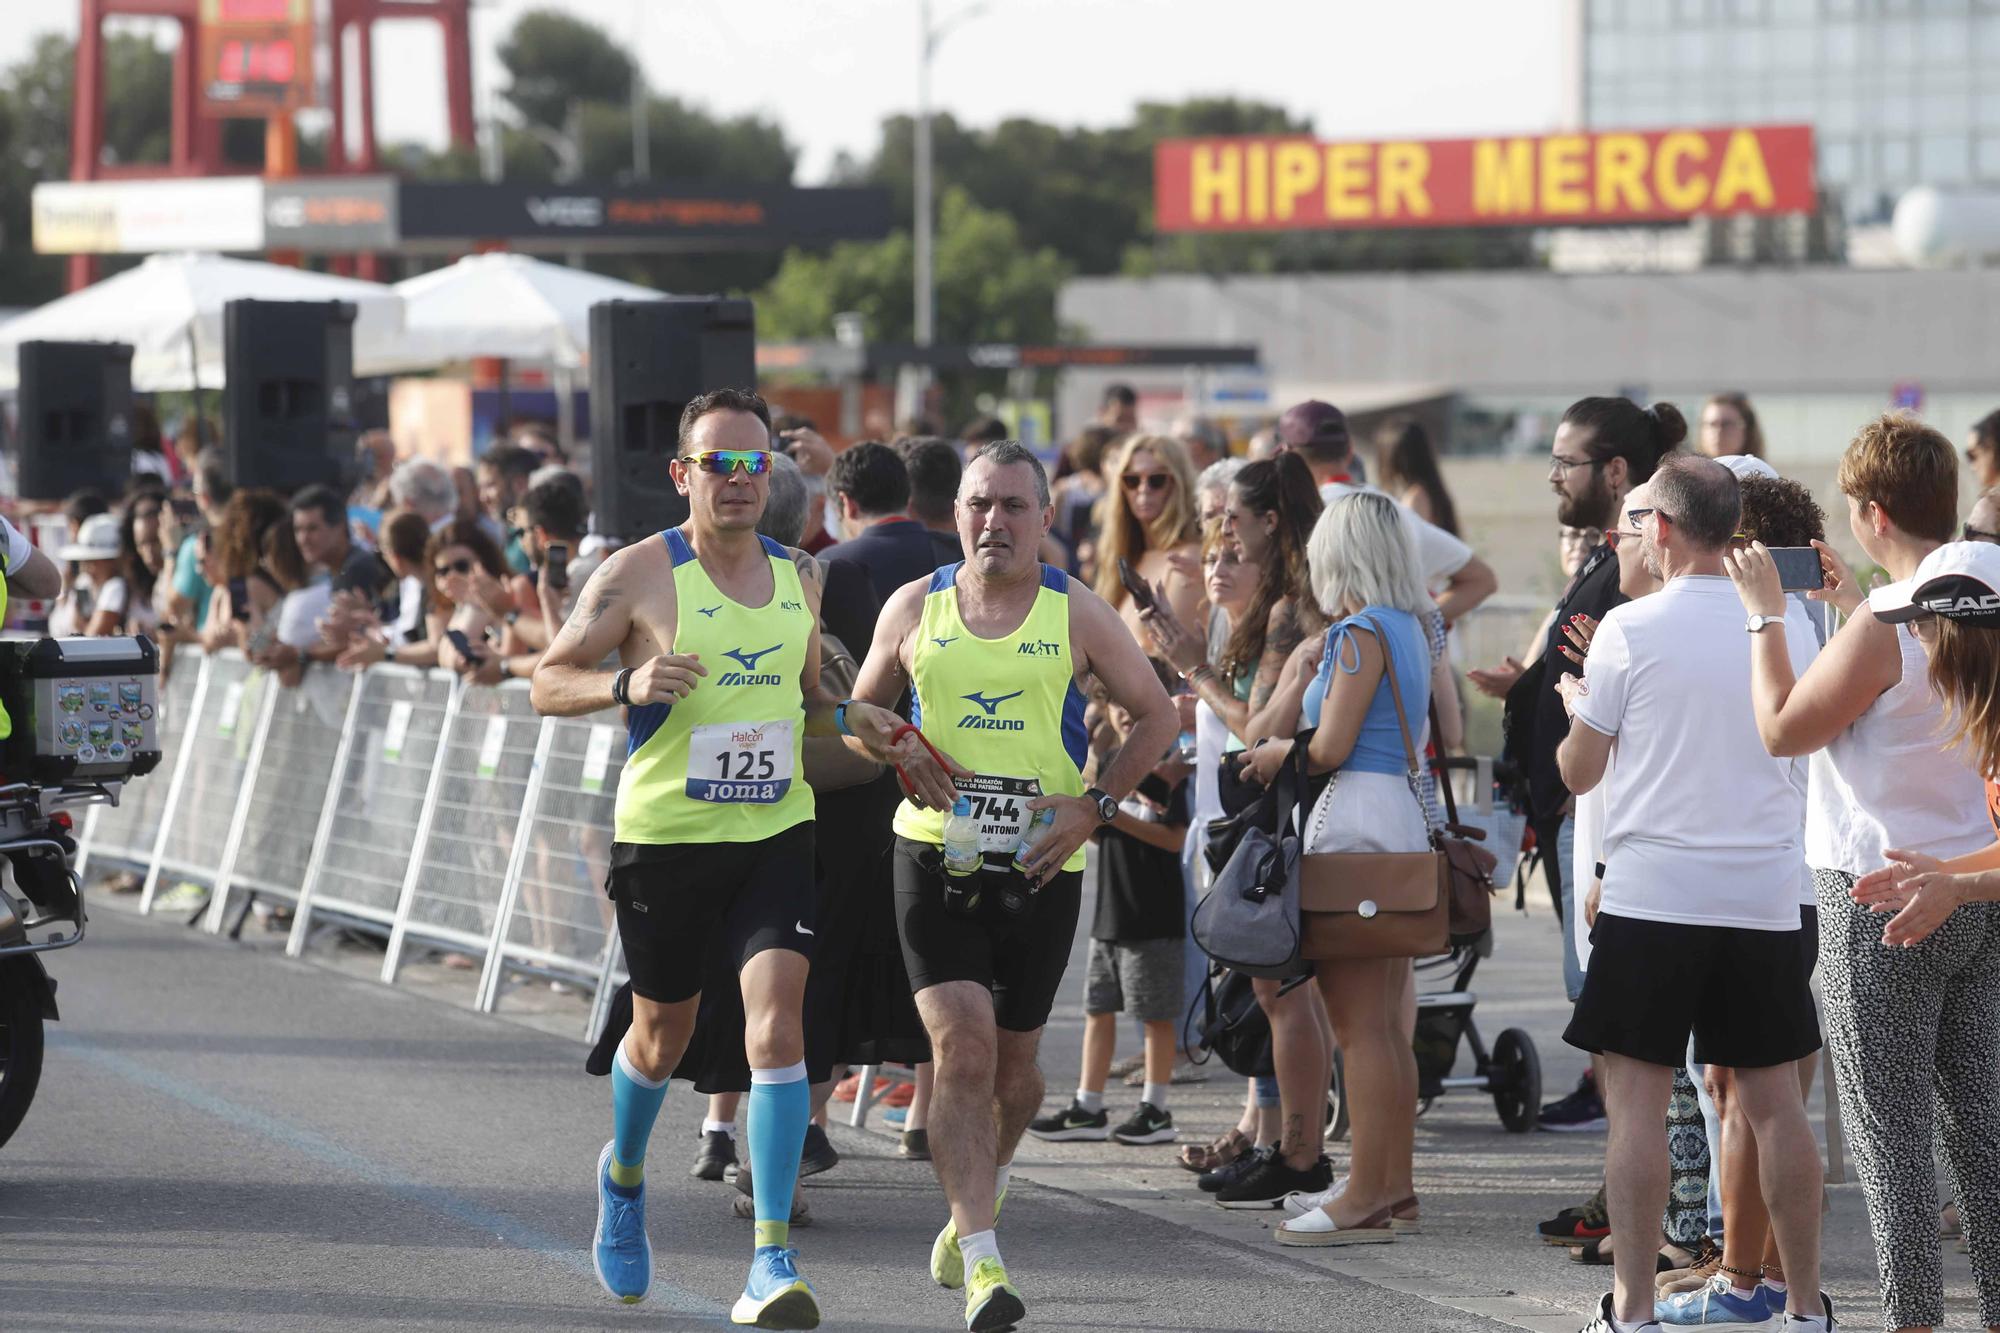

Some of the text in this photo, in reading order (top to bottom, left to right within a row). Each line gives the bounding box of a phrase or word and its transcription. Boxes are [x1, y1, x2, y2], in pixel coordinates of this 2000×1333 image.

[1191, 128, 1775, 222] HIPER MERCA
[717, 672, 781, 686] MIZUNO
[957, 715, 1025, 730] MIZUNO
[716, 750, 774, 780] 125
[974, 777, 1003, 786] MARATÓN
[981, 824, 1020, 835] ANTONIO
